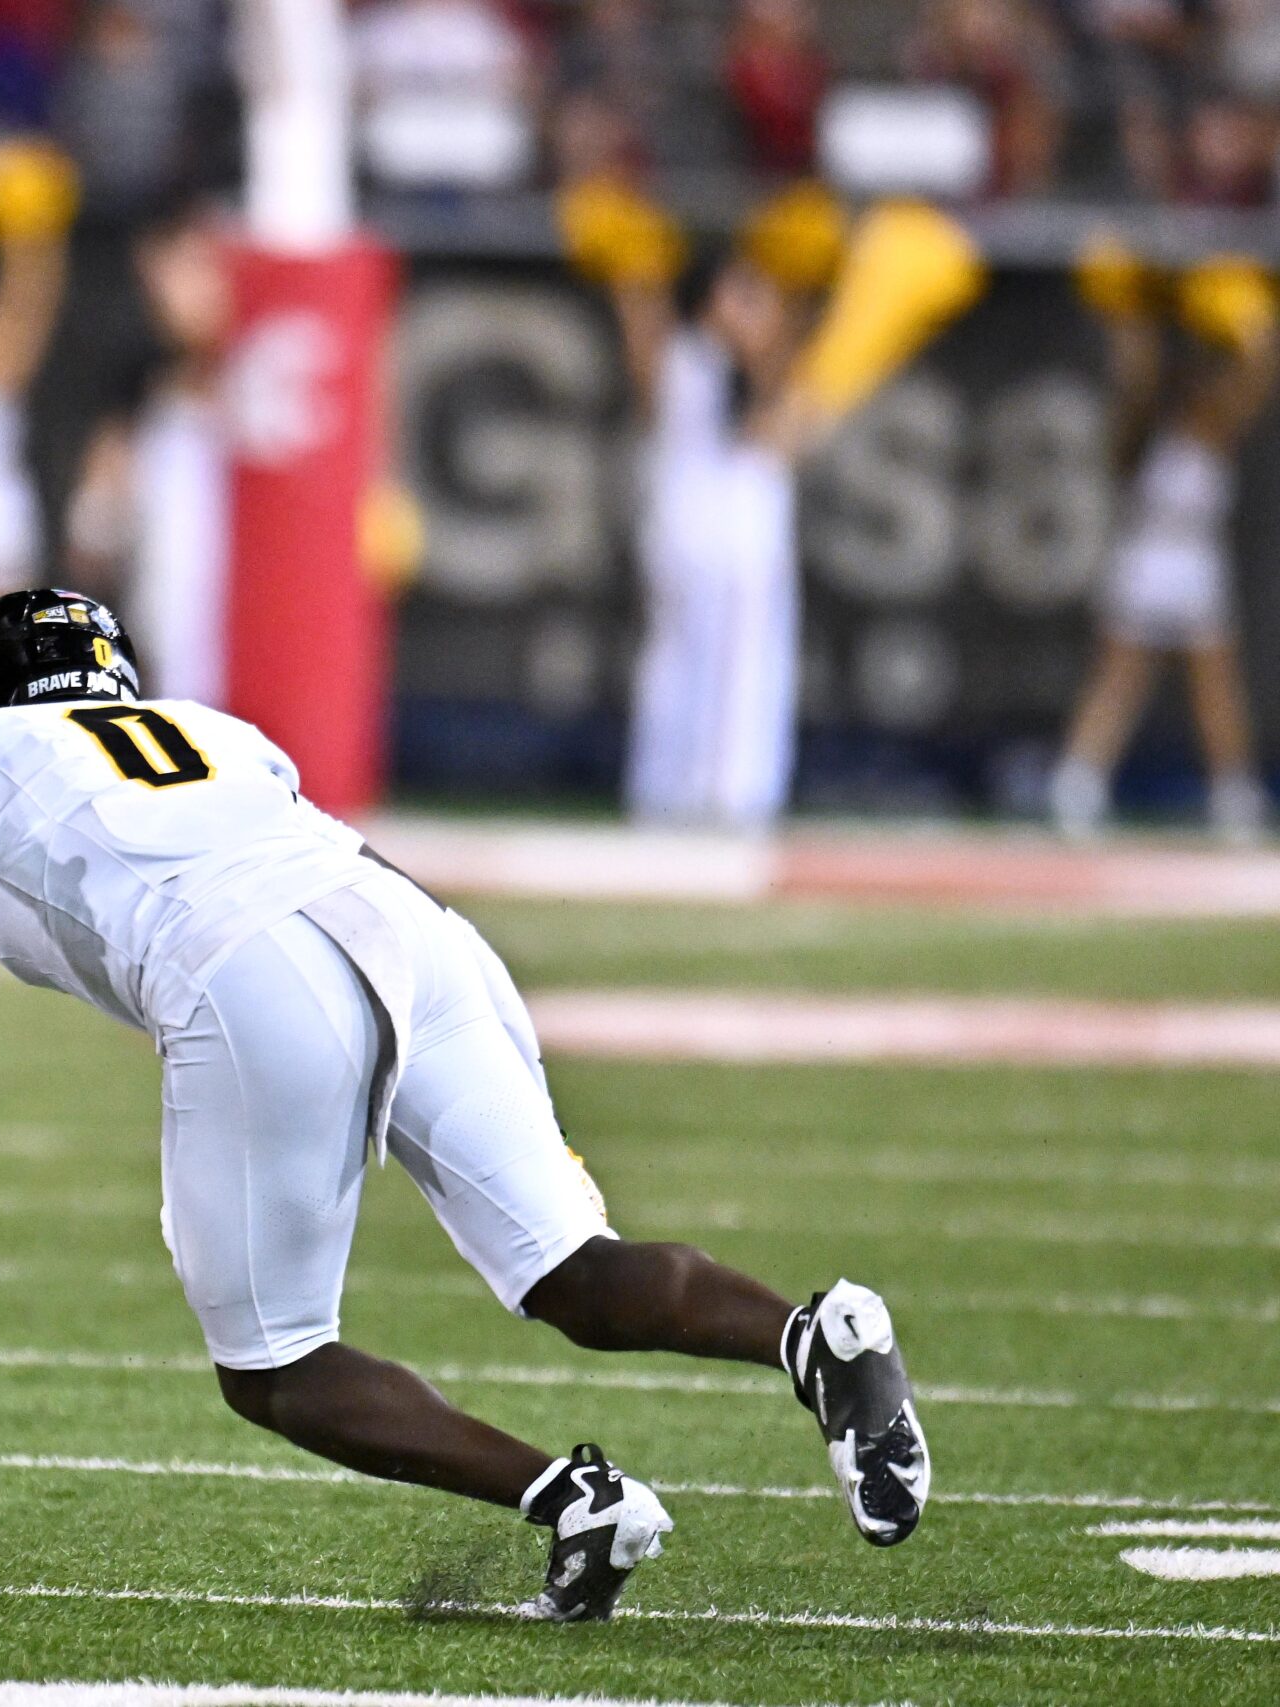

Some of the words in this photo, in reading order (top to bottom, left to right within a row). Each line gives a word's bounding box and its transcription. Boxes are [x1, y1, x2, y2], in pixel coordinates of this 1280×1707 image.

[93, 637, 113, 669] 0
[27, 671, 82, 698] BRAVE
[63, 704, 217, 791] 0
